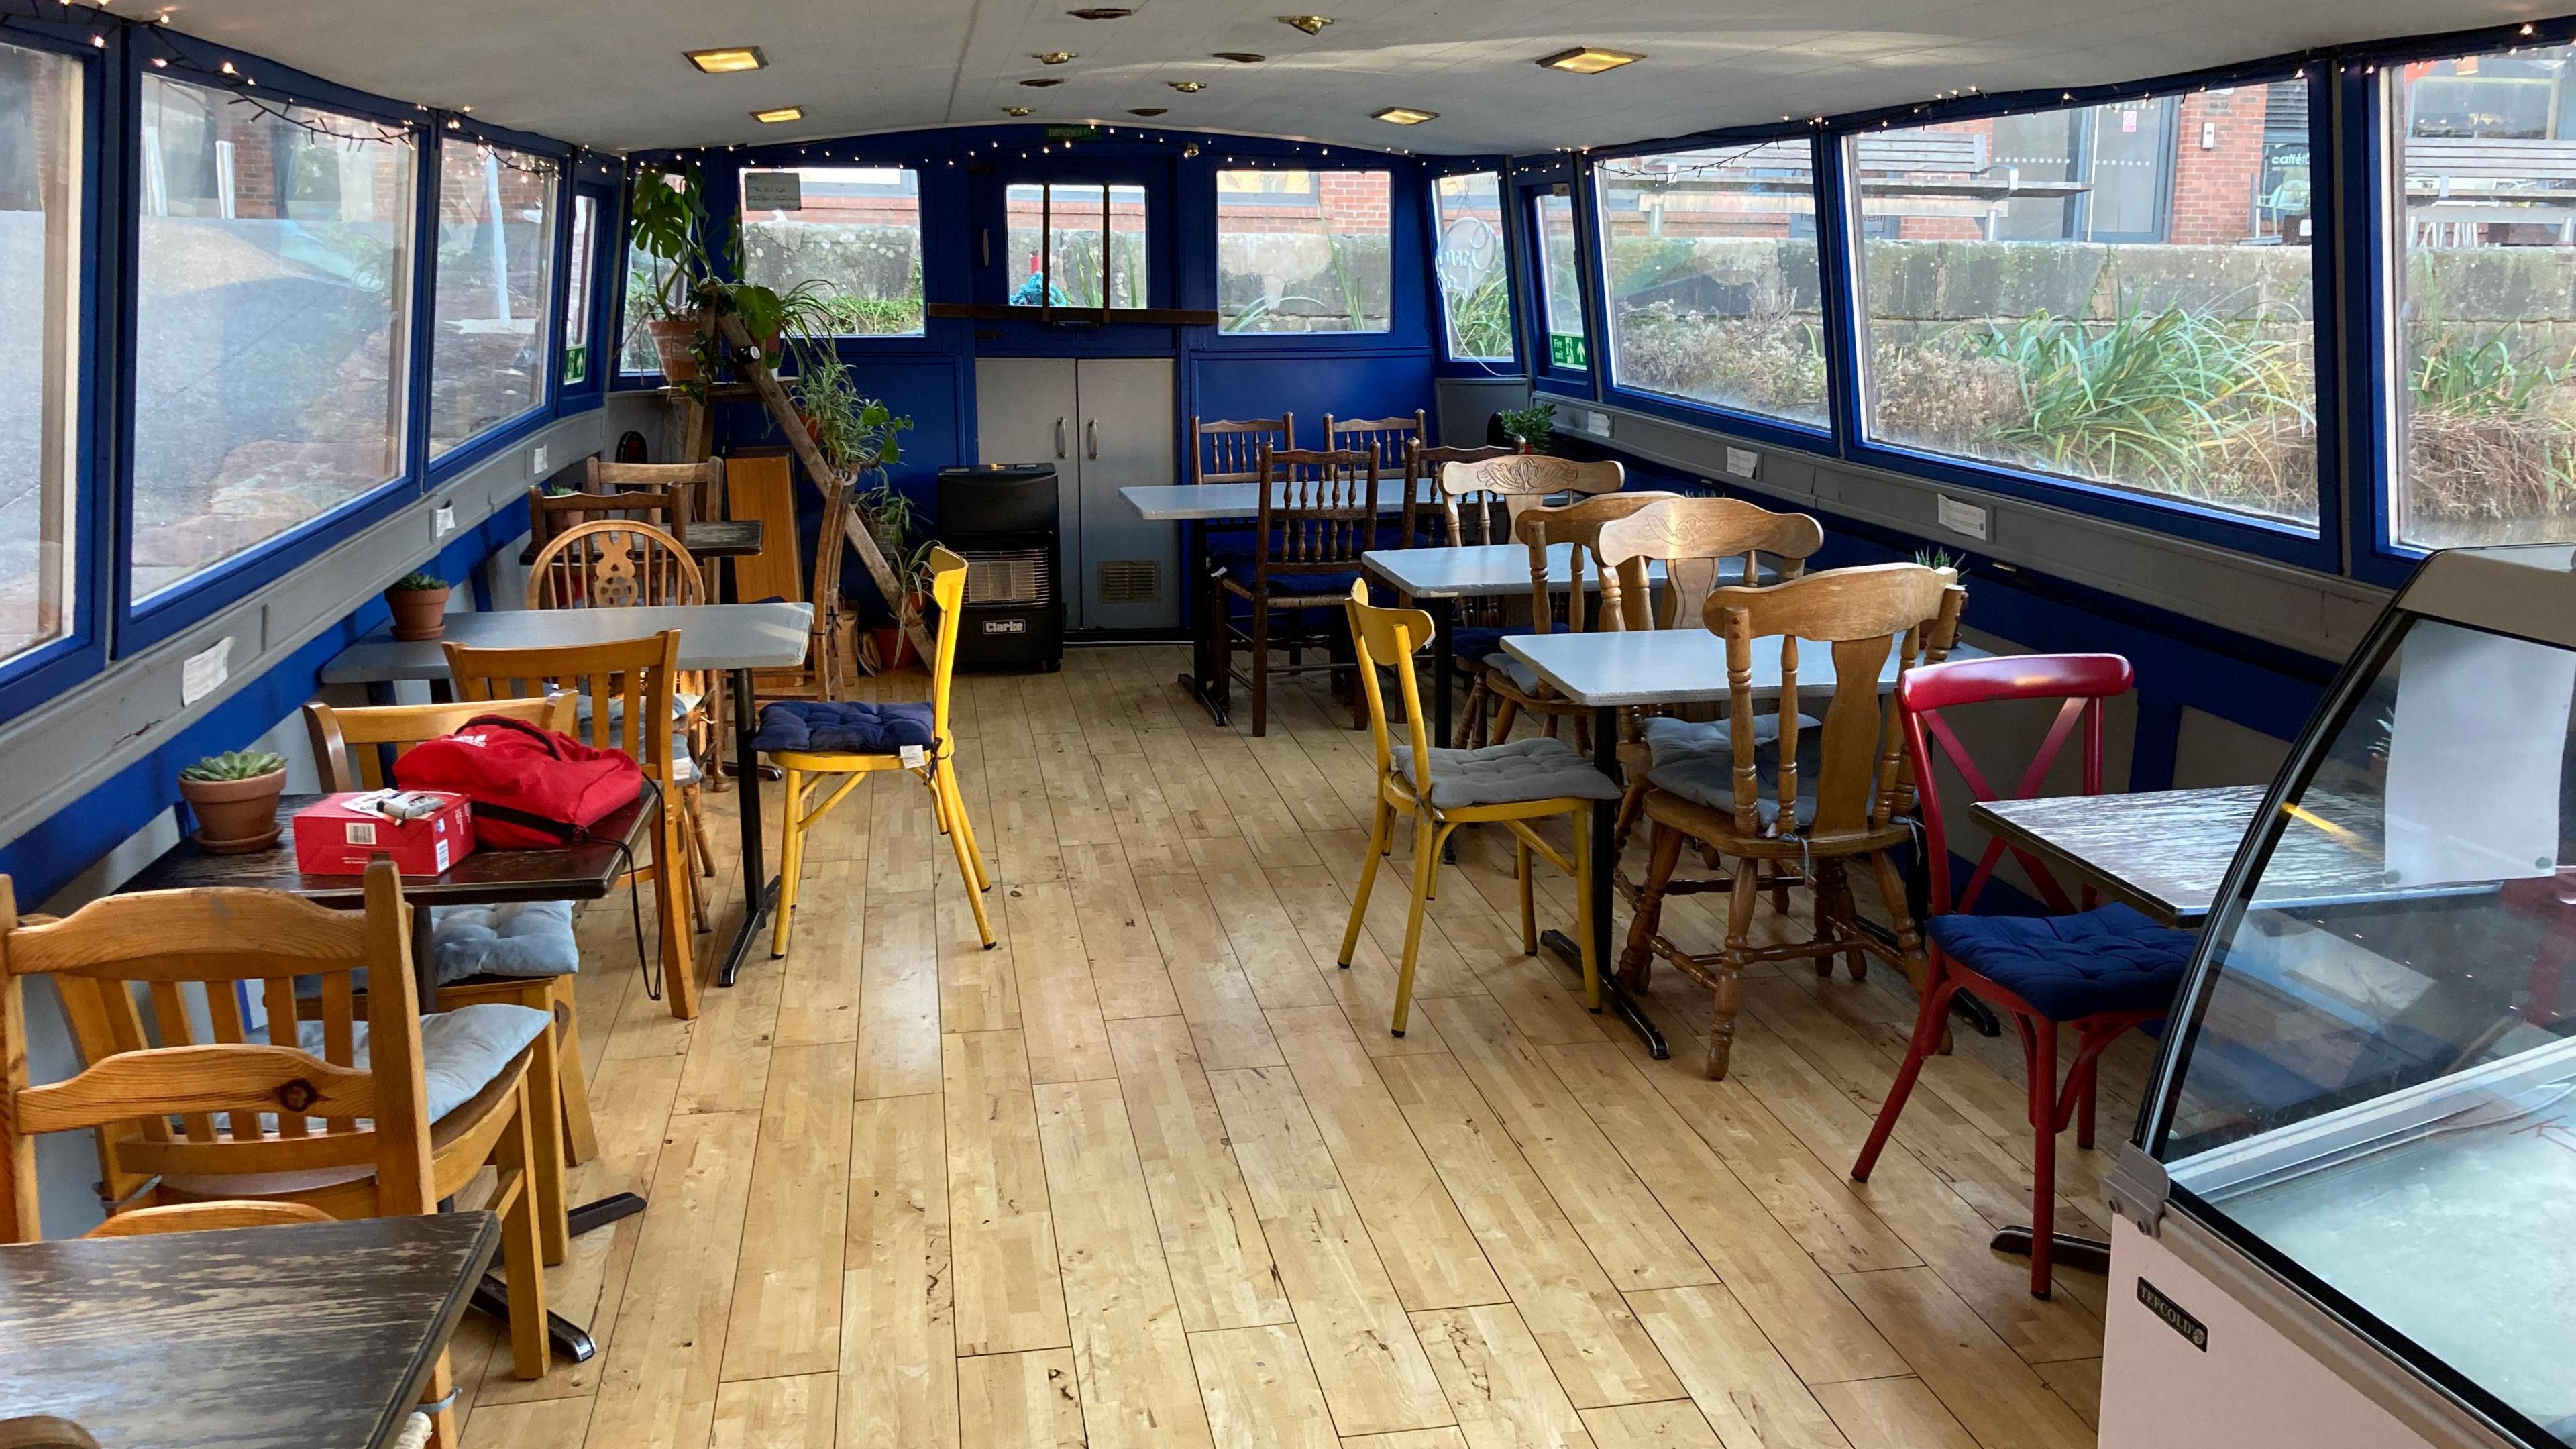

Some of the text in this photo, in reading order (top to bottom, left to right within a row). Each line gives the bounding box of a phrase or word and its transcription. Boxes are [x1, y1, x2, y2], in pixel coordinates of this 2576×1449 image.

[1554, 338, 1562, 348] Fire
[985, 621, 1024, 633] Clarke
[2140, 1285, 2192, 1334] TEFCOLD
